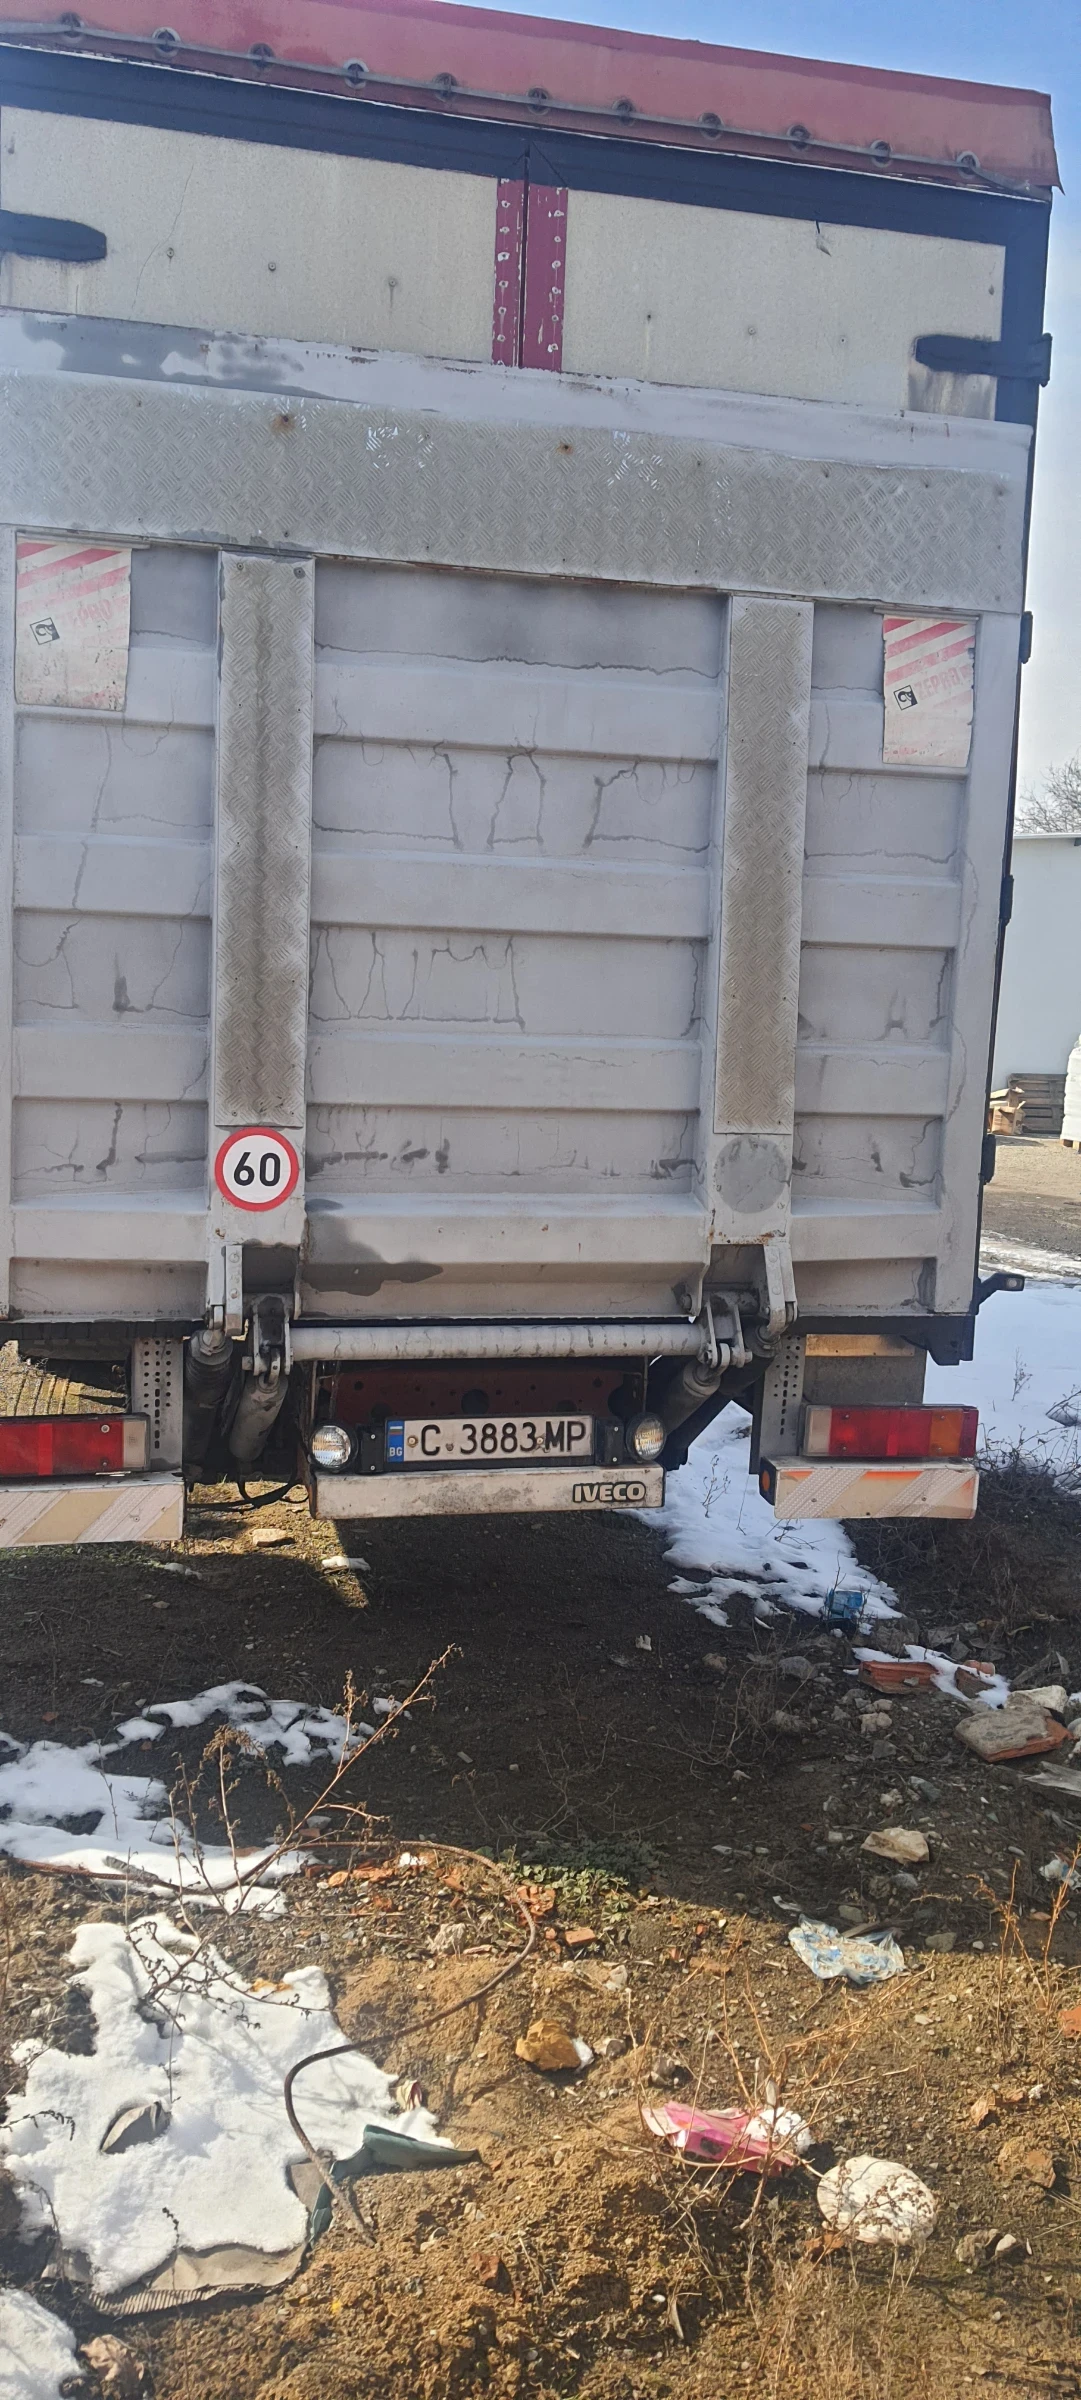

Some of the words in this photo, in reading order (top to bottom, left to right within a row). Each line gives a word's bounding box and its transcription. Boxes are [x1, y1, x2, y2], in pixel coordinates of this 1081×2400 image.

[234, 1152, 281, 1187] 60
[389, 1447, 403, 1457] BG
[421, 1424, 441, 1456] C
[460, 1421, 538, 1455] 3883
[544, 1420, 586, 1453] MP
[573, 1482, 646, 1503] IVECO
